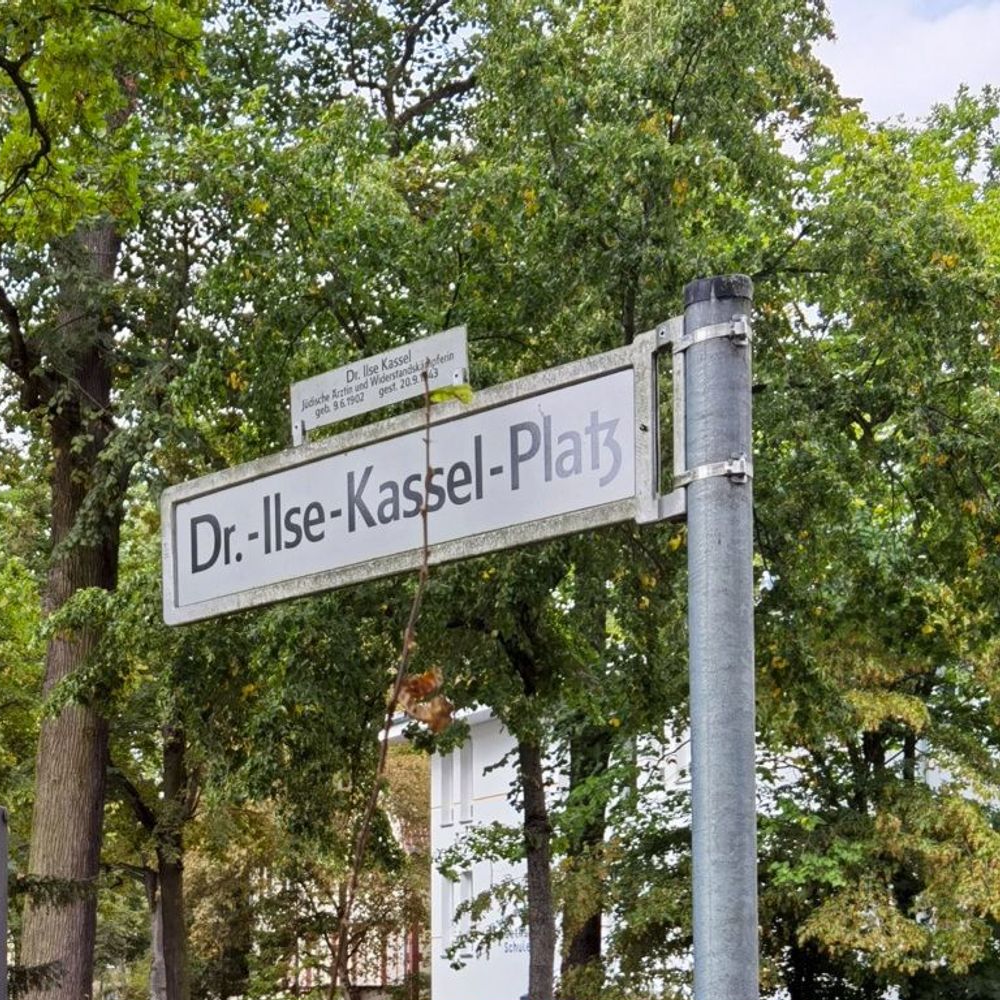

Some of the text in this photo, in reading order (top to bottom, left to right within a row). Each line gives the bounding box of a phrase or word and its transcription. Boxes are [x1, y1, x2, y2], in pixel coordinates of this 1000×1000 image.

[346, 350, 412, 383] Dr. Ilse Kassel
[301, 391, 329, 411] Jüdische
[332, 386, 353, 401] Ärztin
[355, 379, 368, 392] und
[315, 405, 331, 419] geb.
[379, 381, 398, 398] gest.
[190, 410, 622, 574] Dr.-Ilse-Kassel-Platz
